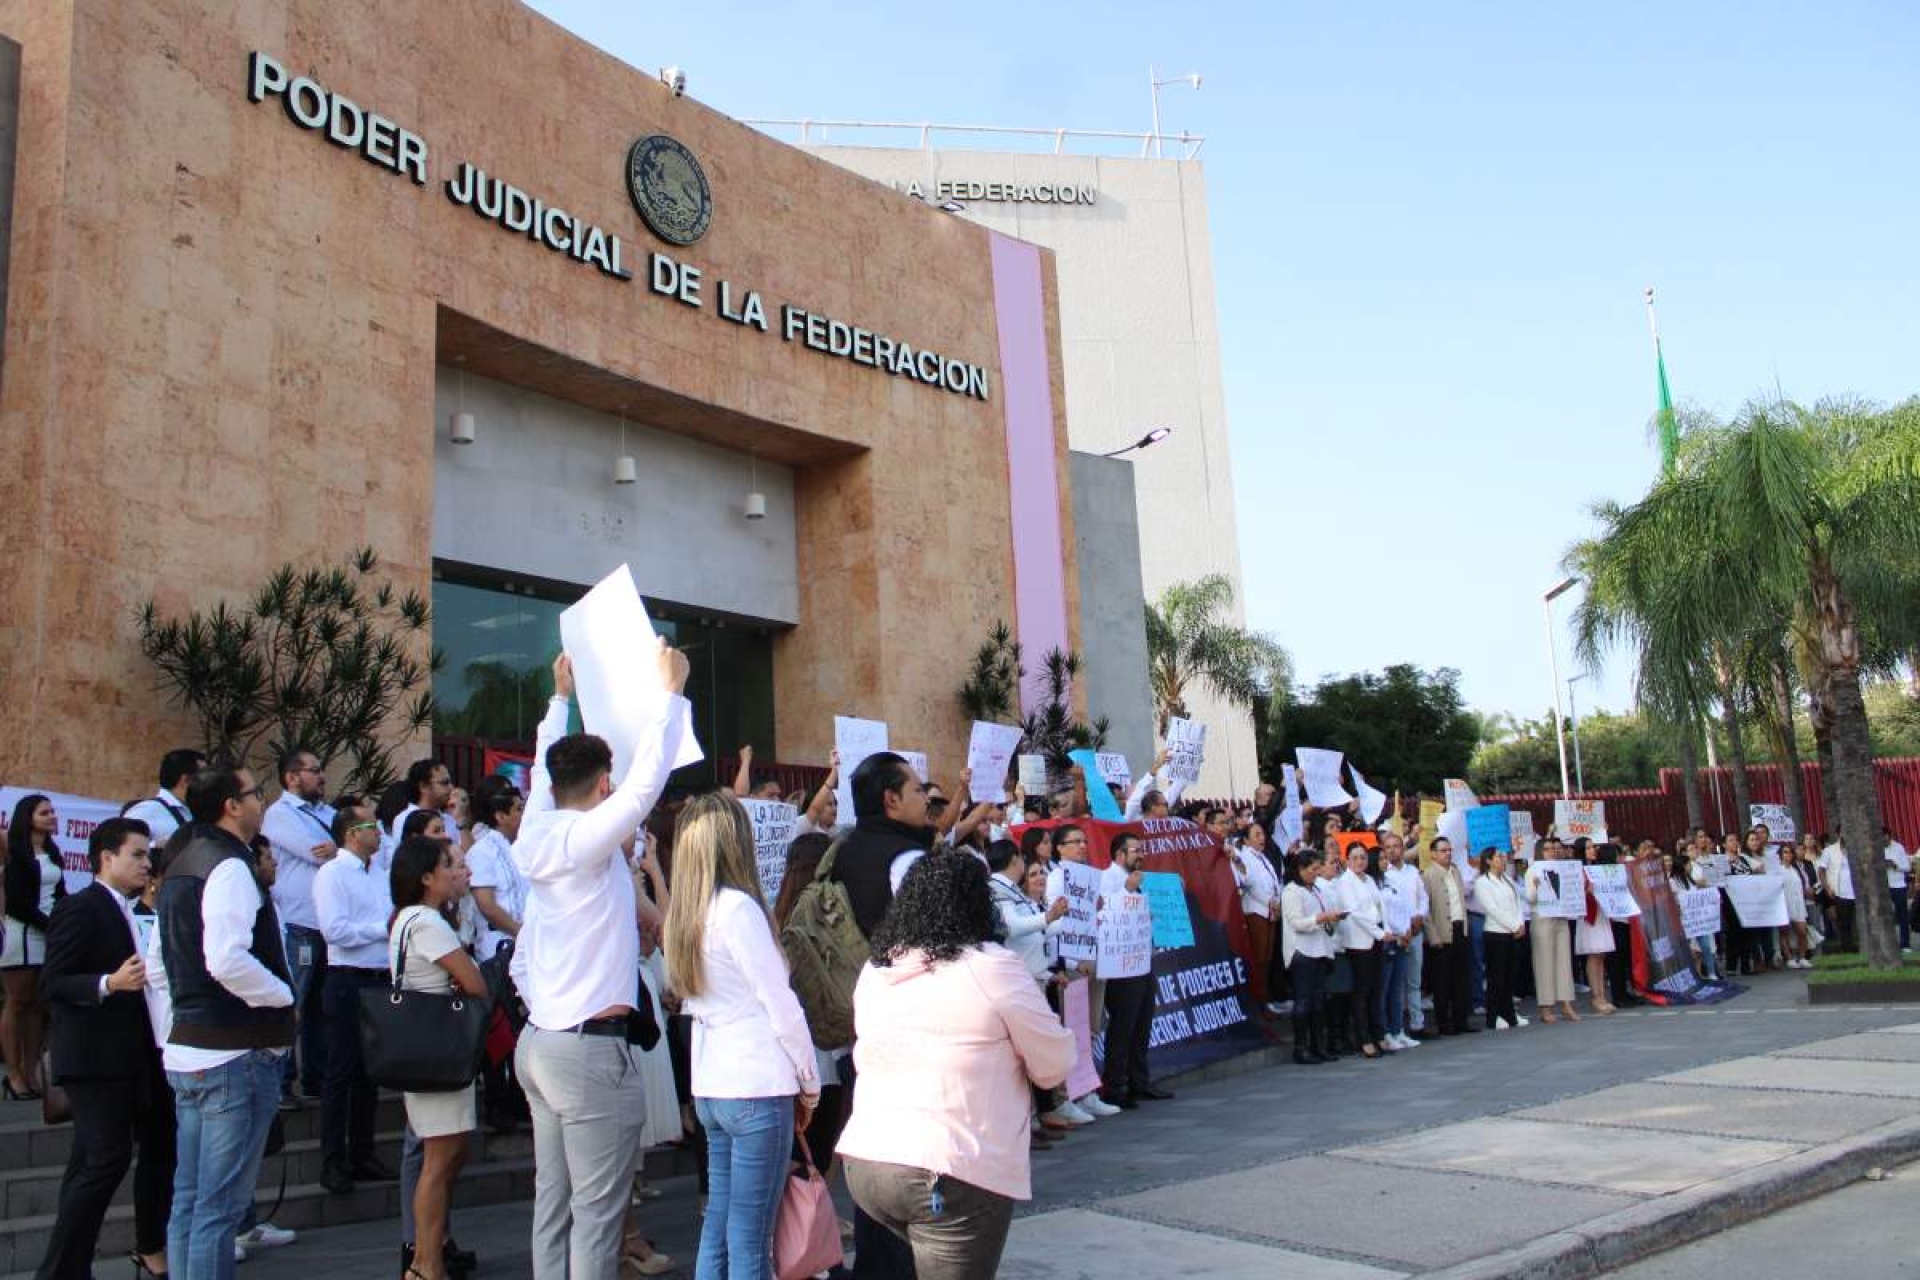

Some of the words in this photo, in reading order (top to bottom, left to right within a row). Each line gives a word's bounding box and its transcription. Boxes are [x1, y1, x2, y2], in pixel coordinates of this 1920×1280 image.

[937, 179, 1096, 206] FEDERACION
[248, 51, 428, 184] PODER
[445, 162, 632, 281] JUDICIAL
[649, 251, 702, 307] DE
[717, 280, 768, 332] LA
[782, 304, 988, 400] FEDERACION
[1157, 974, 1180, 1004] DE
[1175, 960, 1235, 999] PODERES
[1234, 957, 1247, 985] E
[1191, 995, 1248, 1035] JUDICIAL
